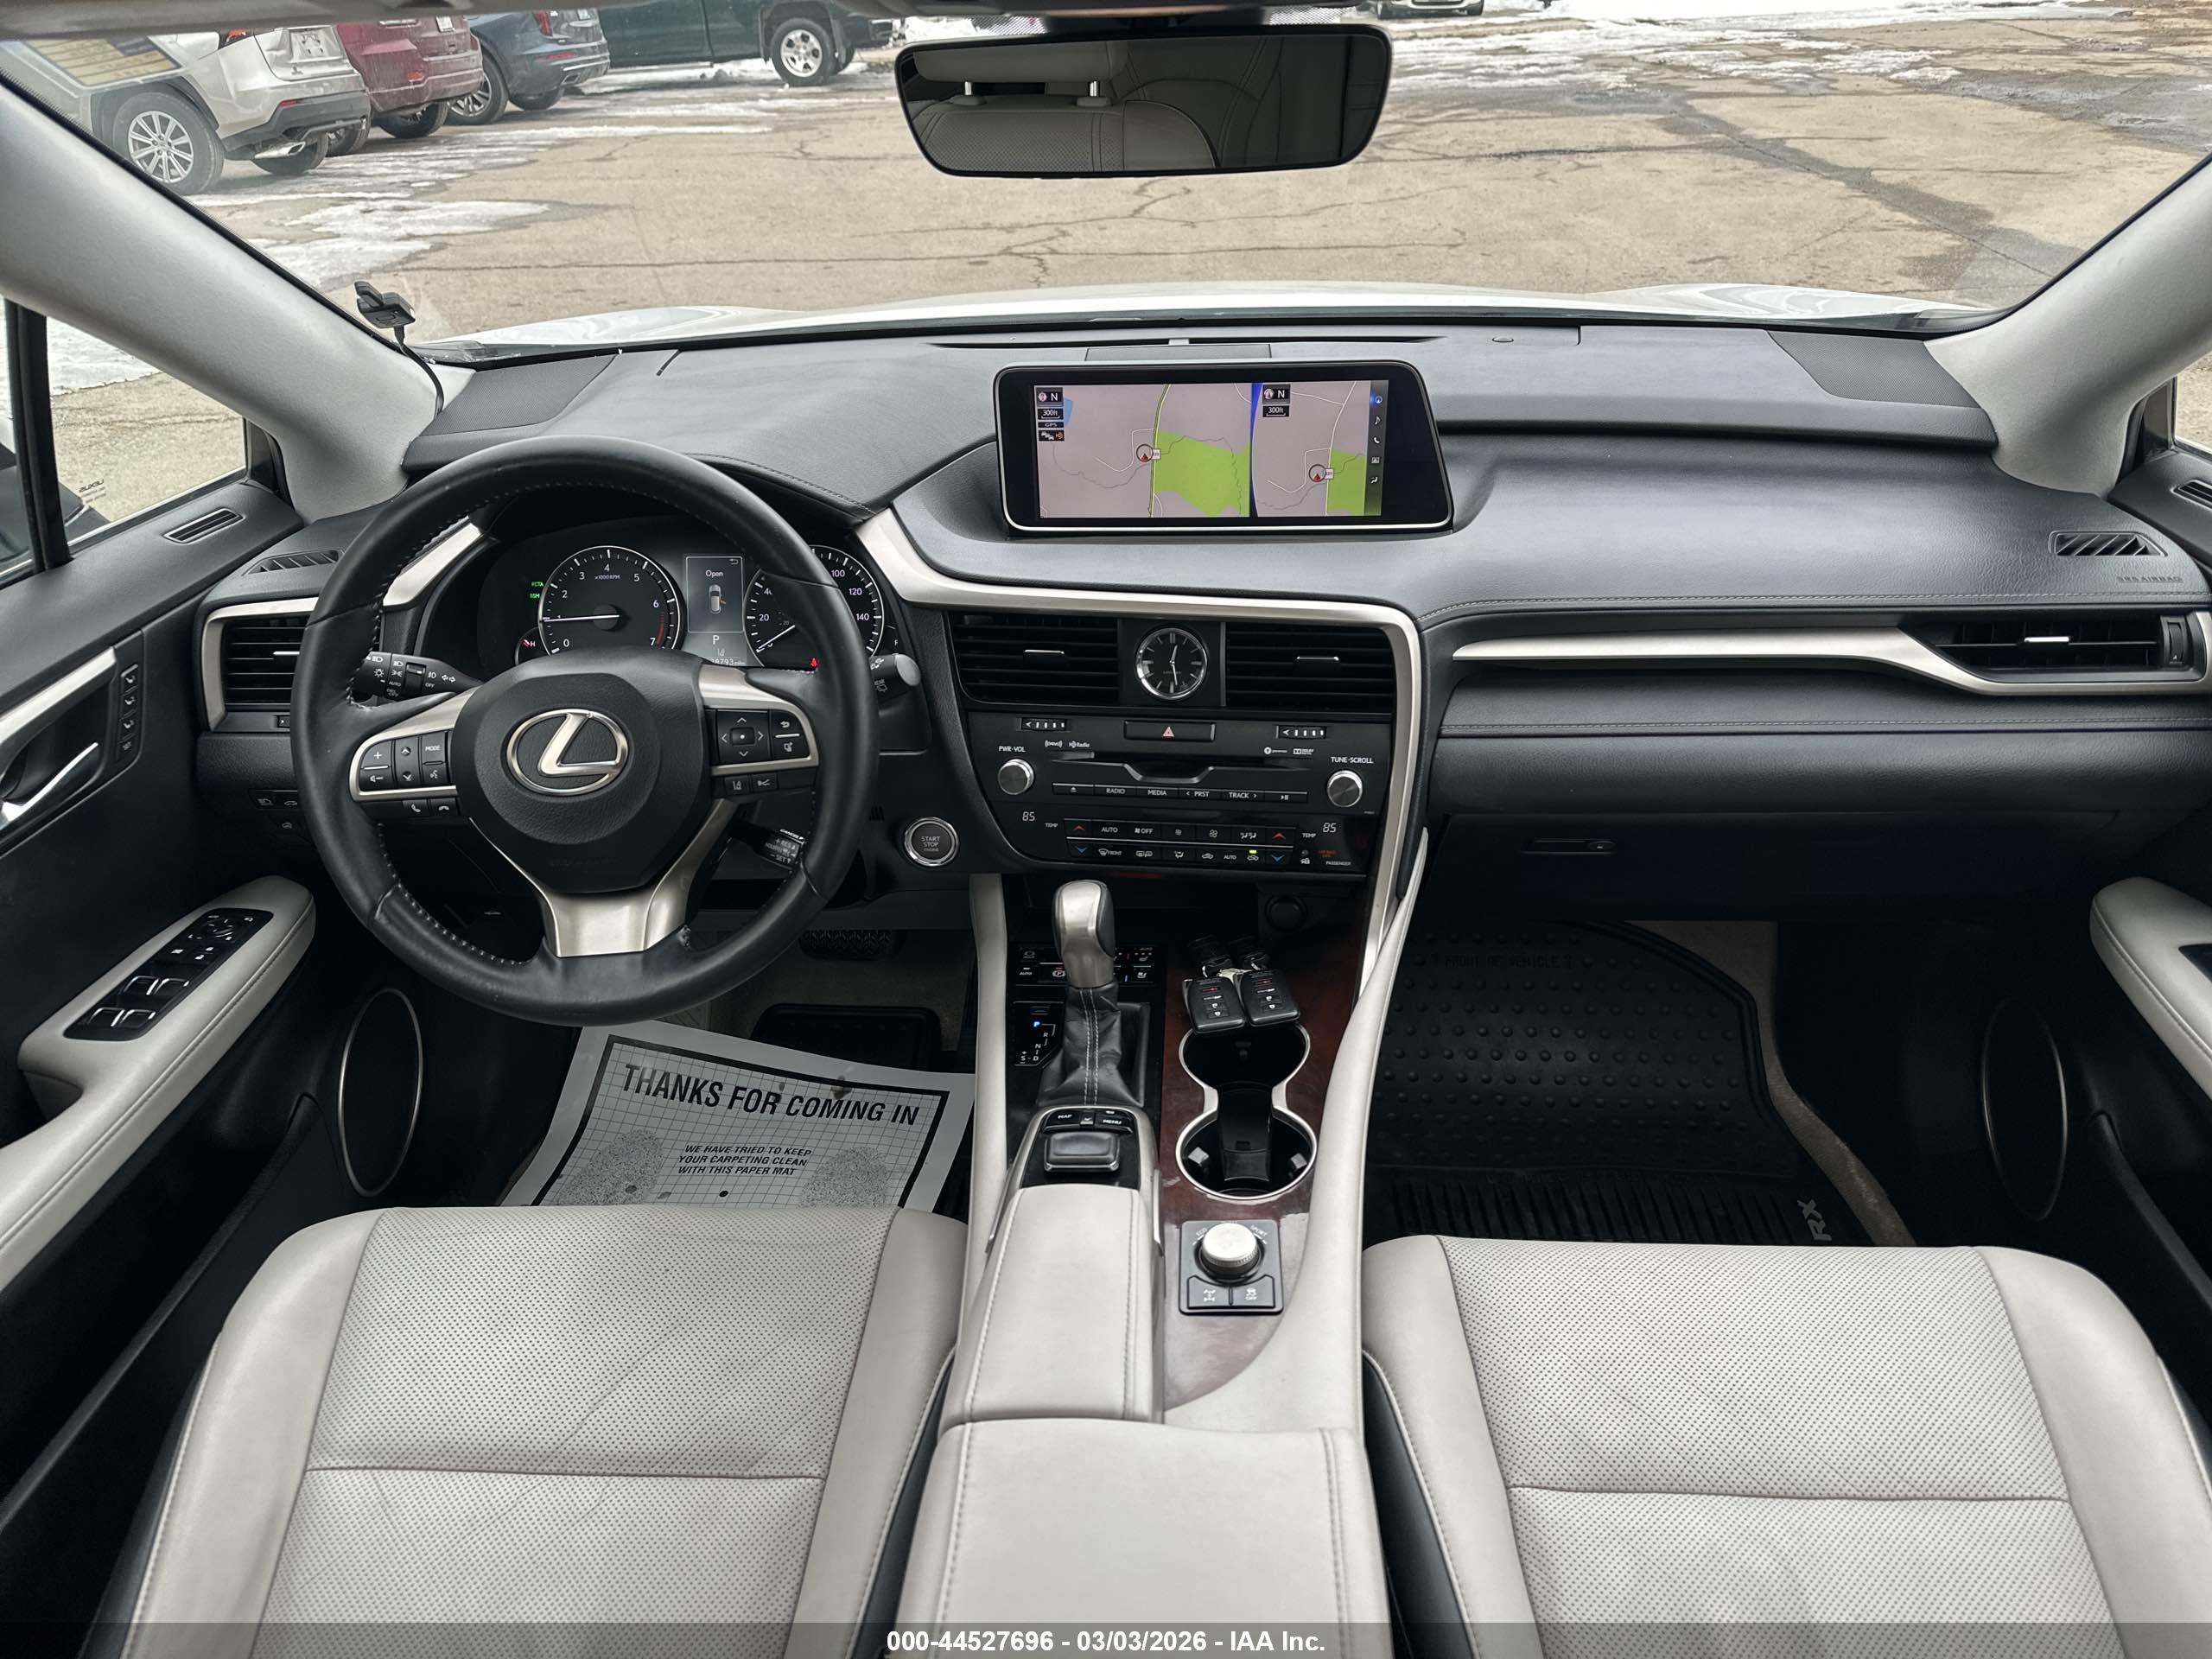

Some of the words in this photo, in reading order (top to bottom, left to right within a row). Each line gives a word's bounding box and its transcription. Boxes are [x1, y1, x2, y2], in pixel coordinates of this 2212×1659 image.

[604, 563, 609, 572] 4
[563, 639, 569, 647] 0
[713, 635, 719, 645] P
[1022, 811, 1036, 822] 85
[1322, 823, 1337, 833] 85
[623, 1064, 723, 1107] THANKS
[728, 1086, 782, 1115] FOR
[785, 1096, 886, 1121] COMING
[891, 1104, 919, 1125] IN
[784, 1147, 812, 1157] KEEP
[678, 1155, 708, 1164] YOUR
[709, 1155, 770, 1165] CARPETING
[772, 1157, 807, 1166] CLEAN
[677, 1166, 705, 1174] WITH
[709, 1166, 733, 1174] THIS
[735, 1166, 770, 1175] PAPER
[772, 1166, 797, 1175] MAT
[1796, 1199, 1832, 1241] RX
[1196, 1228, 1208, 1236] ECO
